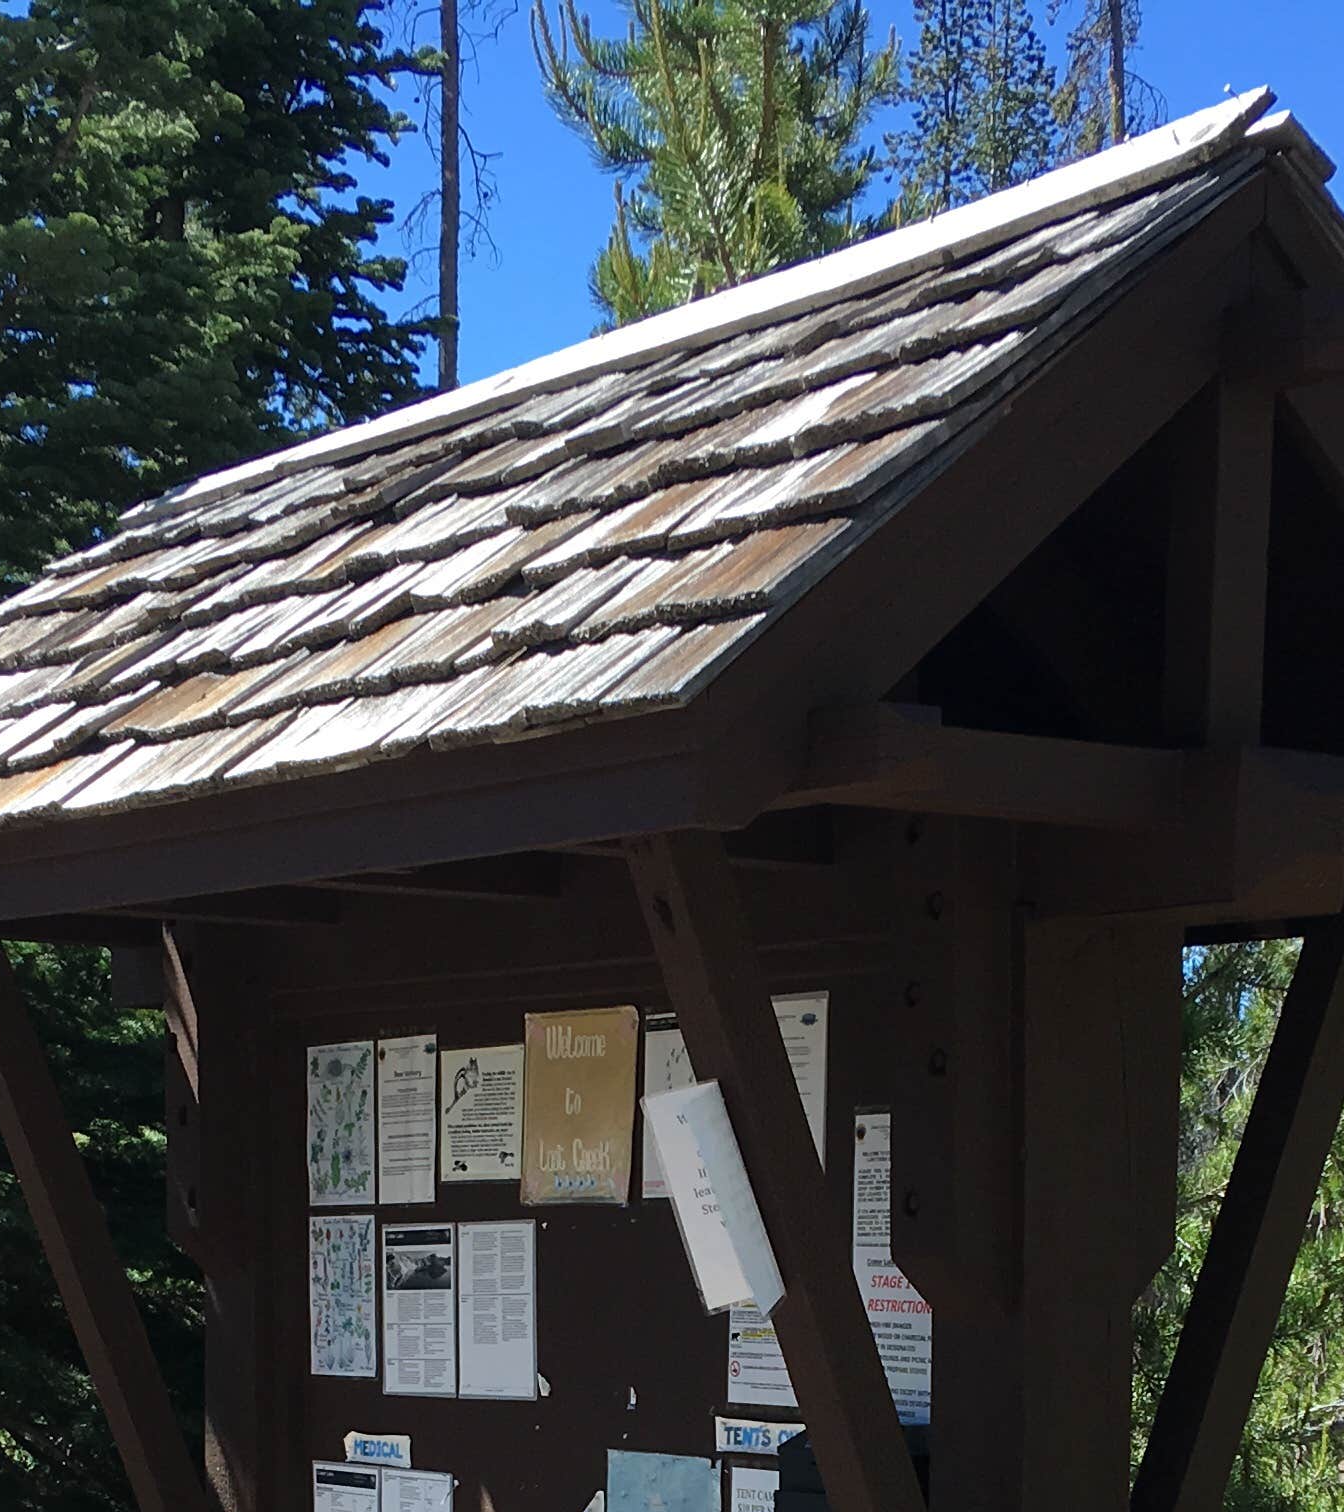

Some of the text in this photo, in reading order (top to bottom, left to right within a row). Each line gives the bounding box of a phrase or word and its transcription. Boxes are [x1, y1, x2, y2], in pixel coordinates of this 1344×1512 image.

[545, 1025, 606, 1060] Welcome
[565, 1087, 582, 1115] to
[871, 1274, 904, 1289] STAGE
[867, 1298, 931, 1315] RESTRICTION
[353, 1439, 403, 1459] MEDICAL
[736, 1488, 756, 1501] TENT
